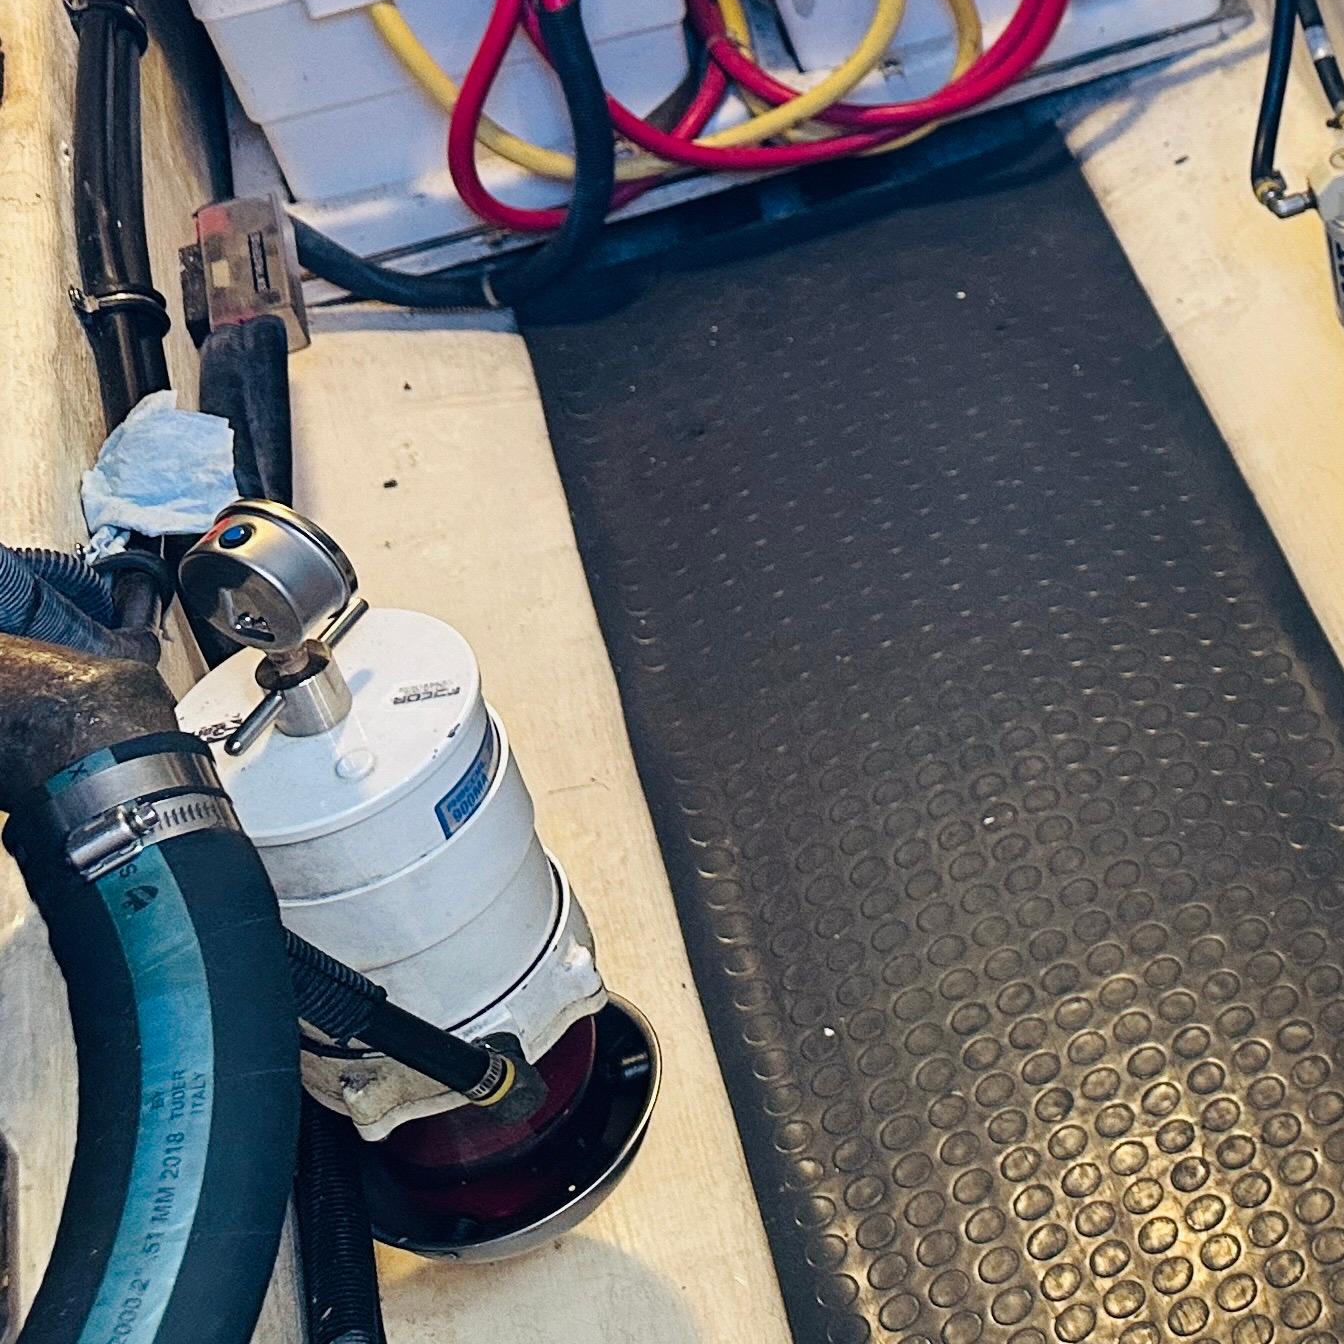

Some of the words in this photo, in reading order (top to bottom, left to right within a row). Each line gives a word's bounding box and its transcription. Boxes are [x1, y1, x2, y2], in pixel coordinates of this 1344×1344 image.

[191, 1071, 206, 1116] ITALY
[162, 1130, 185, 1180] 2018
[152, 1187, 176, 1223] MM
